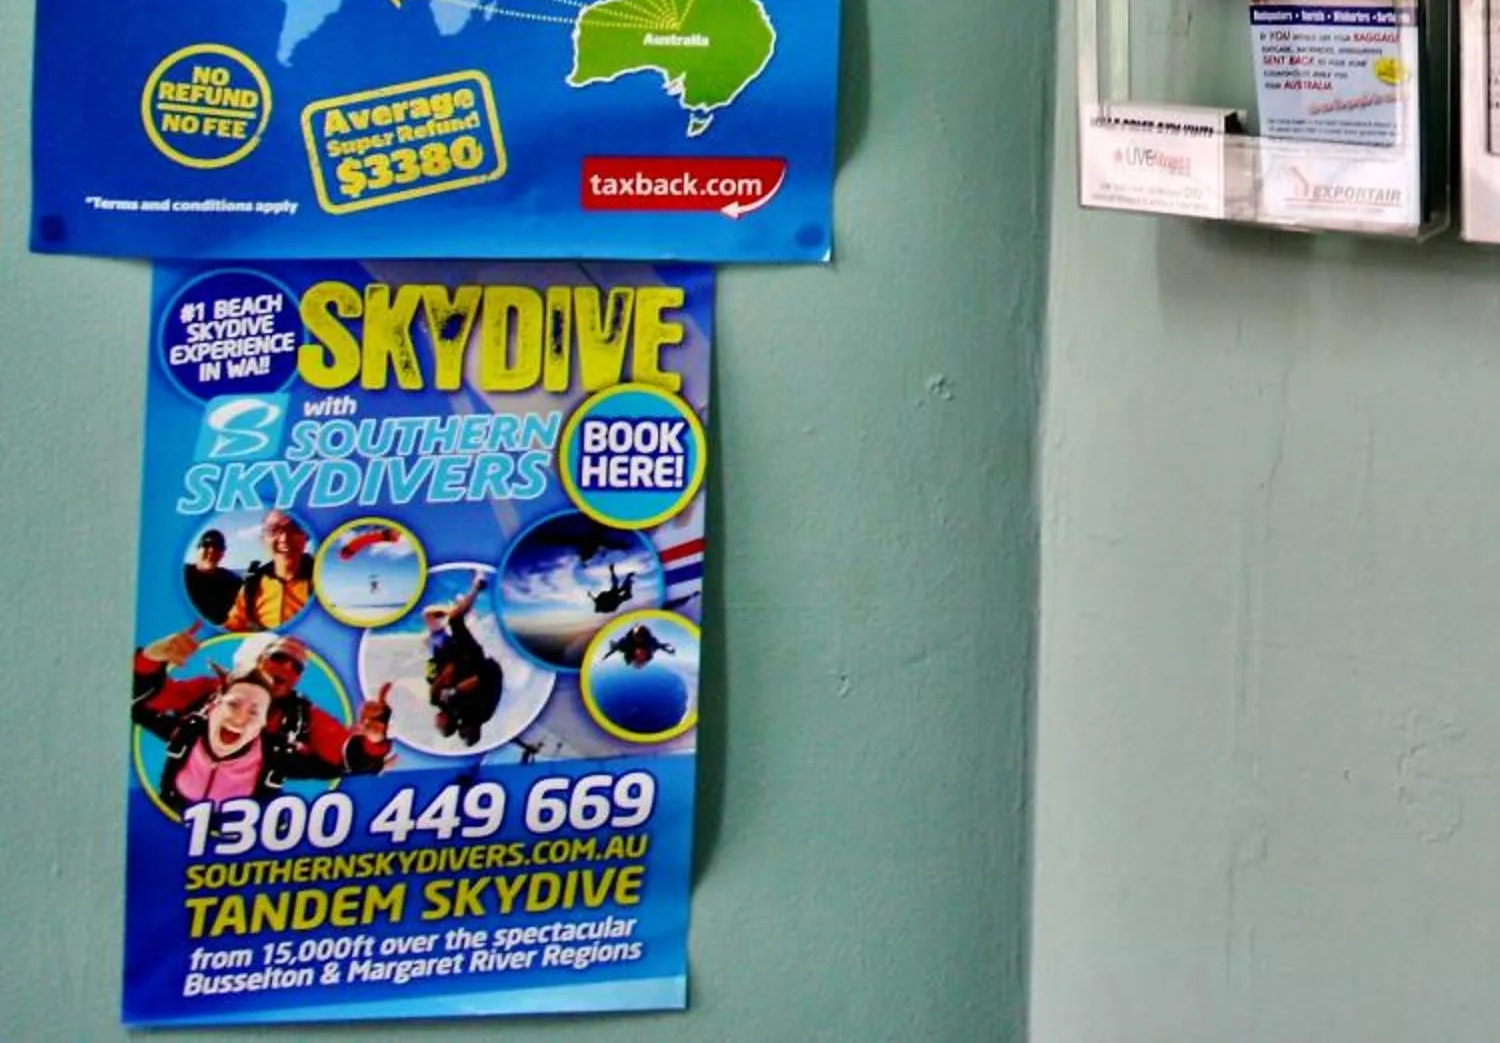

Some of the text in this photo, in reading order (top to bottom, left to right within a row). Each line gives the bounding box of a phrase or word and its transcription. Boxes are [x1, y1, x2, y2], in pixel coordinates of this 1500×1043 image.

[644, 33, 710, 47] Australia
[192, 66, 231, 86] NO
[157, 82, 259, 110] REFUND
[323, 88, 475, 139] Average
[161, 115, 247, 140] NO FEE
[326, 111, 480, 158] Super Refund
[335, 136, 484, 197] $3380
[590, 173, 762, 196] taxback.com
[141, 197, 169, 212] and
[173, 197, 253, 213] conditions
[256, 199, 299, 217] apply
[180, 294, 283, 323] #1 BEACH
[186, 316, 276, 341] SKYDIVE
[297, 281, 686, 393] SKYDIVE
[169, 333, 296, 365] EXPERIENCE
[199, 361, 222, 382] IN
[303, 395, 357, 418] with
[286, 411, 562, 460] SOUTHERN
[583, 420, 685, 457] BOOK
[177, 452, 553, 515] SKYDIVERS
[581, 455, 685, 490] HERE!
[183, 772, 656, 857] 1300 449 669
[186, 835, 649, 891] SOUTHERNSKYDIVERS.COM.AU
[186, 865, 645, 939] TANDEM SKYDIVE
[190, 916, 637, 971] from 15,000ft over the spectacular
[183, 940, 642, 997] Busselton & Margaret River Regions
